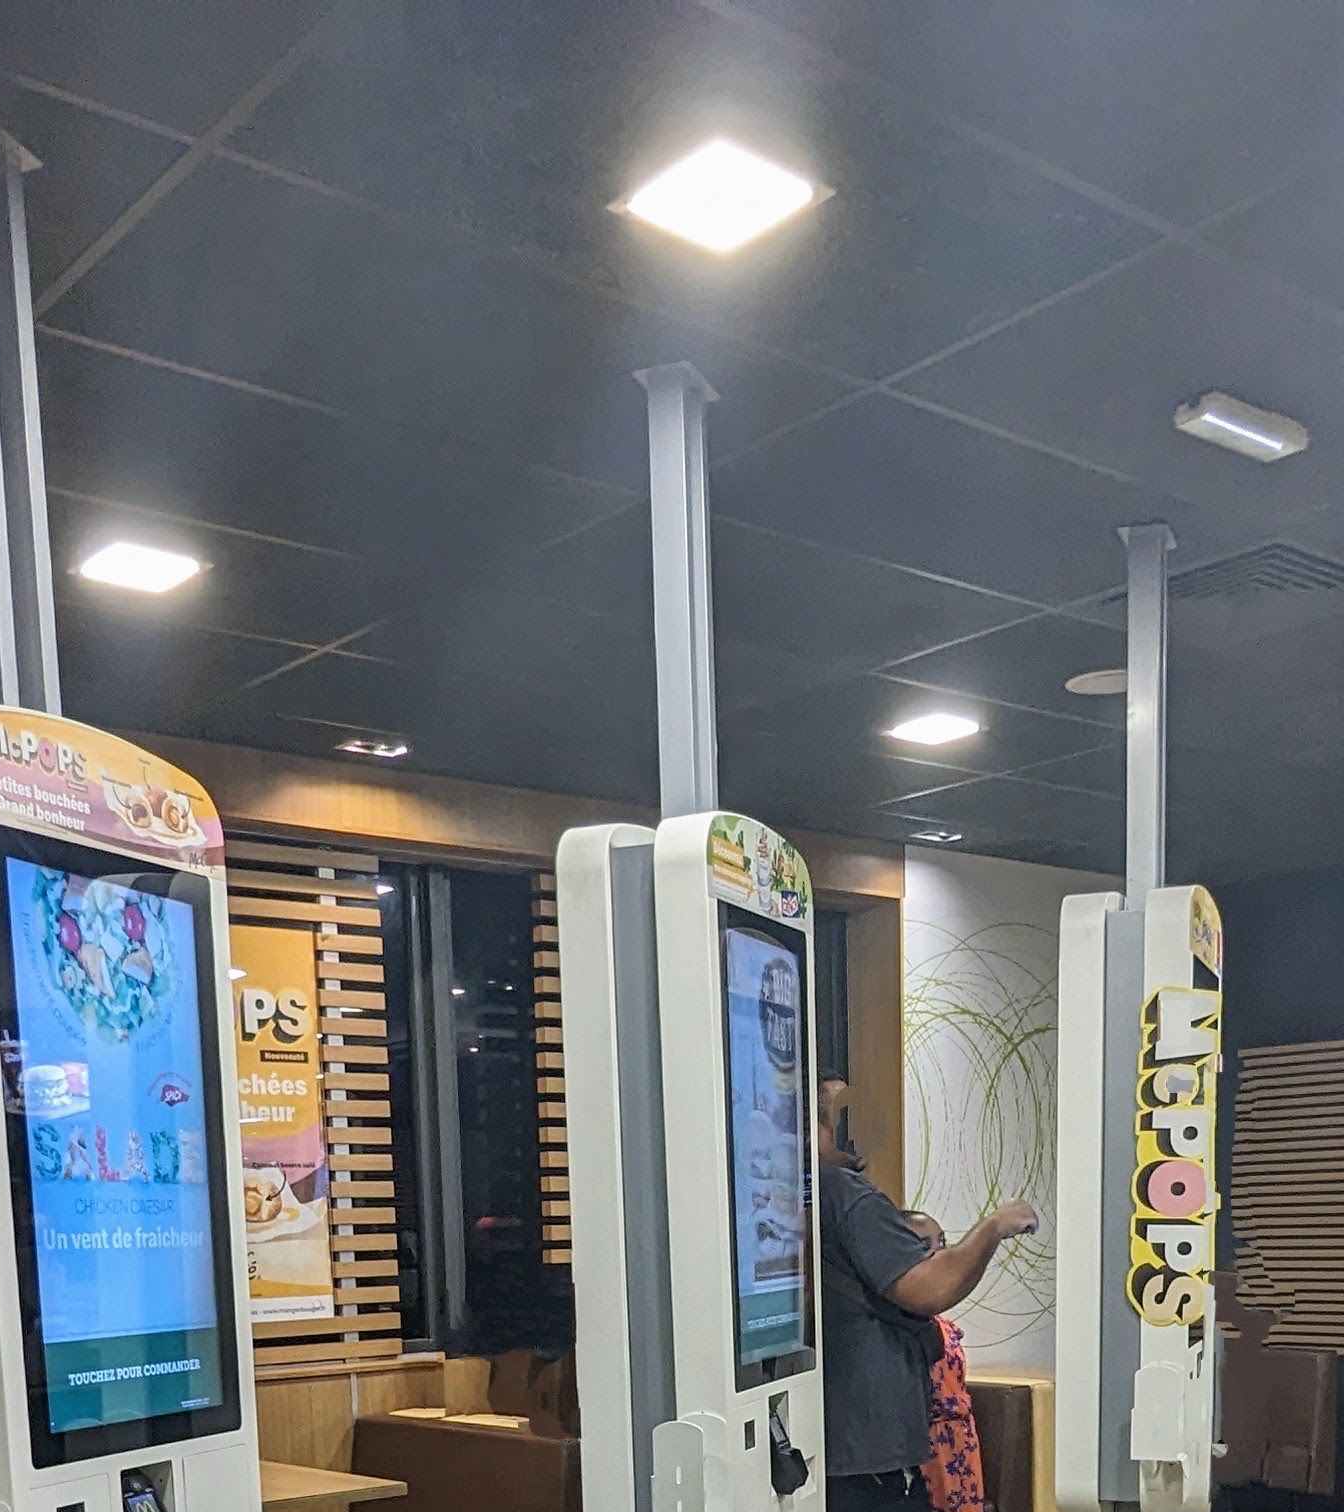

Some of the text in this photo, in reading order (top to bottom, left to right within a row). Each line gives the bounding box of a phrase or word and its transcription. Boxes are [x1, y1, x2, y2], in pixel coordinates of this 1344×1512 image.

[33, 782, 92, 815] bouchées
[36, 802, 87, 832] bonheur
[240, 988, 312, 1044] PS
[264, 1052, 306, 1062] Nouveauté
[239, 1072, 308, 1096] chées
[240, 1101, 296, 1122] heur
[32, 1122, 203, 1184] SALADE
[75, 1198, 176, 1215] CHICKEN CAESAR
[43, 1229, 68, 1250] Un
[70, 1228, 109, 1249] vent
[112, 1226, 133, 1248] de
[67, 1358, 202, 1387] TOUCHEZ POUR COMMANDER
